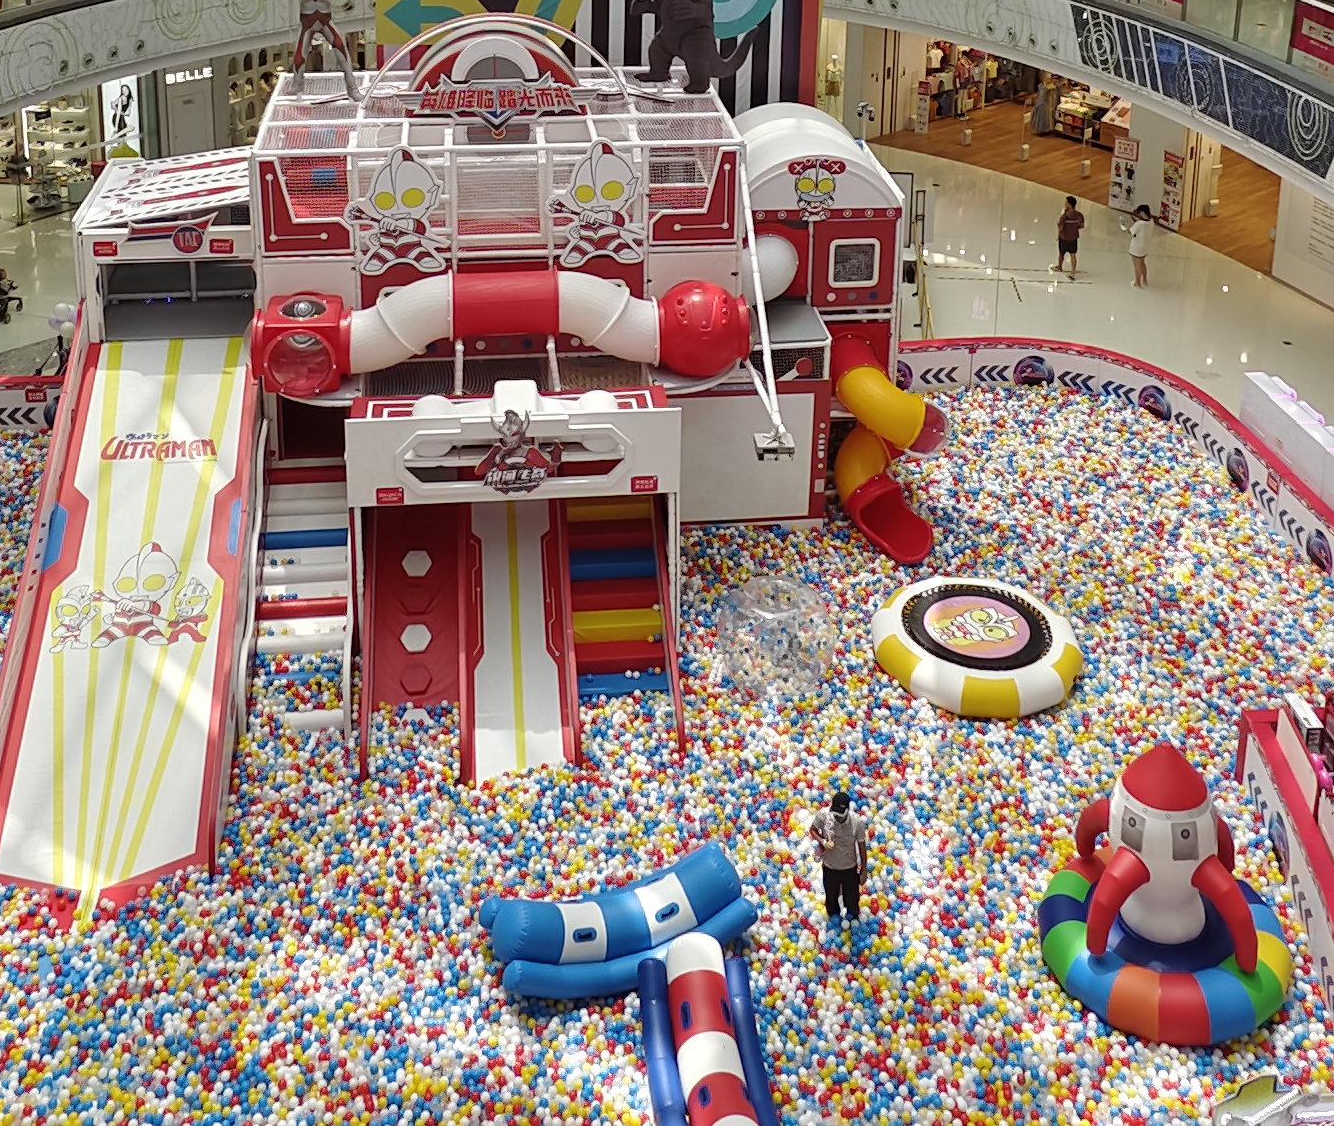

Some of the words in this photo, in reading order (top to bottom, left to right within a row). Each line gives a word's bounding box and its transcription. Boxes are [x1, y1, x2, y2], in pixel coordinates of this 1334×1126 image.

[165, 64, 214, 85] BELLE
[421, 87, 495, 110] 英雄降临
[498, 85, 575, 110] 踏光而来
[100, 436, 218, 462] ULTRAMAN
